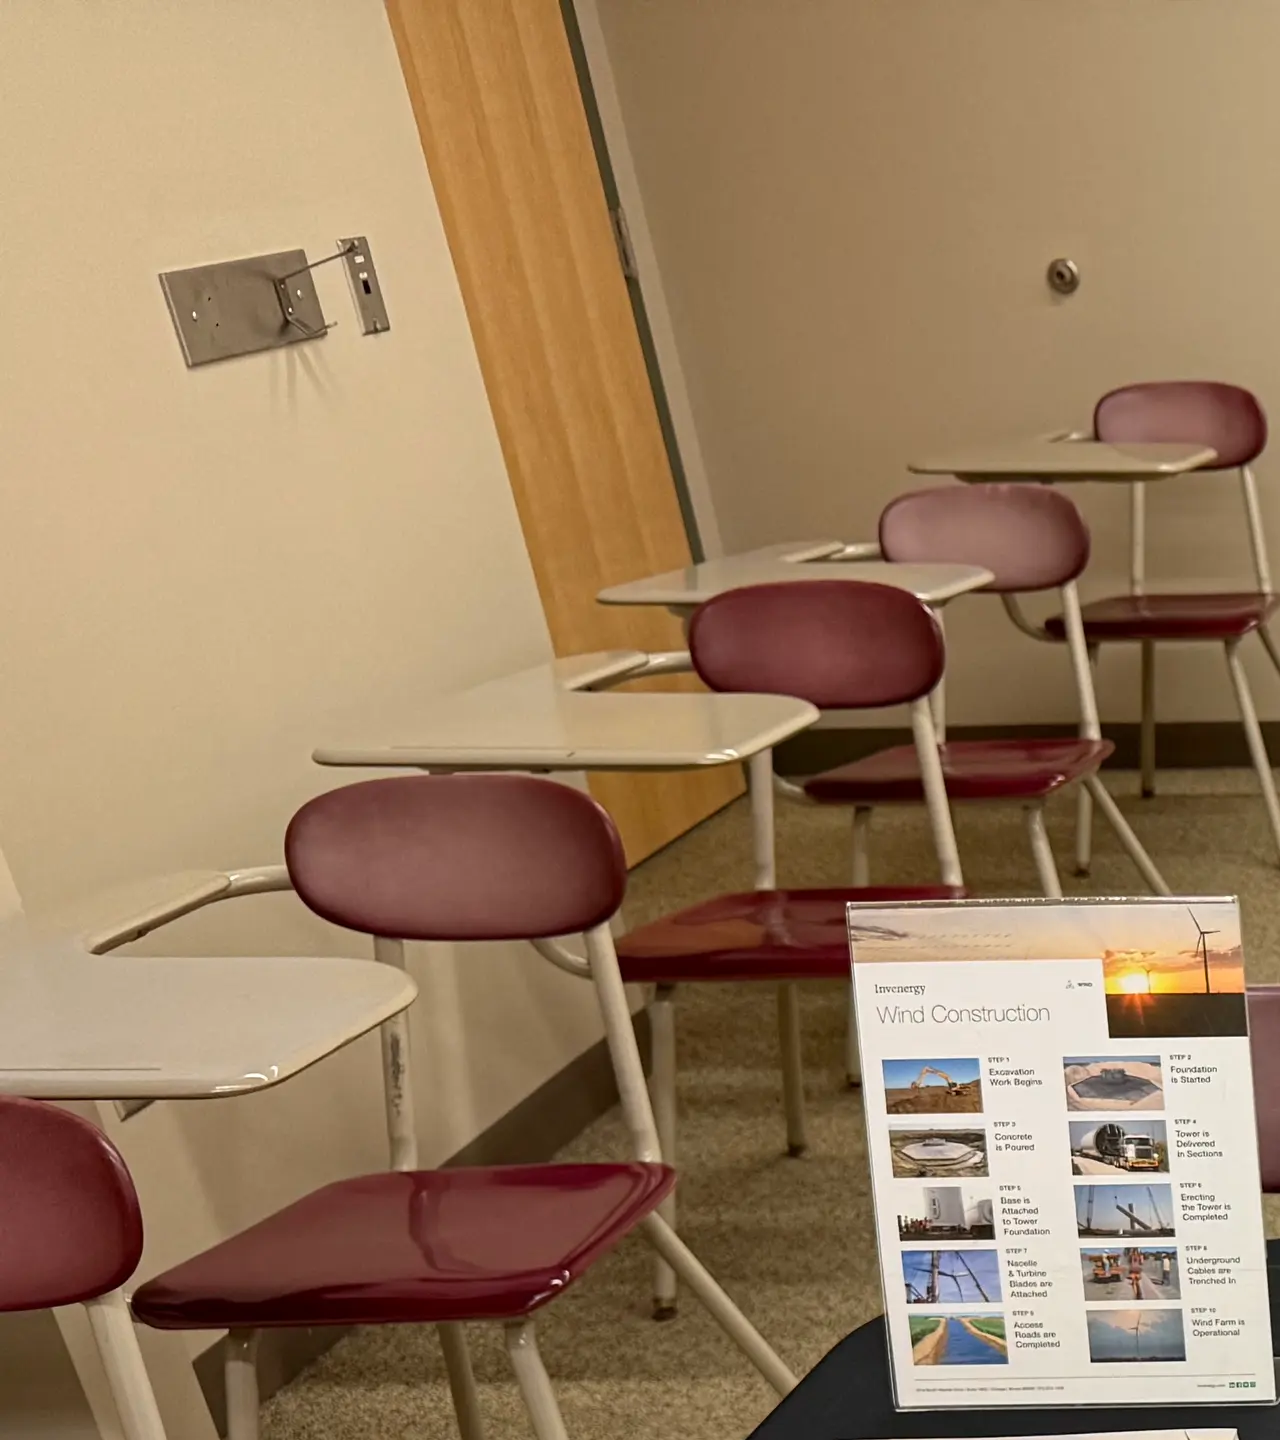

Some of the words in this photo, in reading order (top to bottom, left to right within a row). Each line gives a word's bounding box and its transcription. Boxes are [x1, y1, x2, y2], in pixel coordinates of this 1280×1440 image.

[875, 984, 926, 995] Invenergy
[876, 1005, 925, 1024] Wind
[931, 1004, 1050, 1023] Construction
[989, 1068, 1034, 1076] Excavation
[990, 1078, 1011, 1086] Work
[1014, 1078, 1042, 1087] Begins
[995, 1133, 1032, 1141] Concrete
[1005, 1143, 1035, 1151] Poured
[1176, 1140, 1215, 1148] Delivered
[1187, 1150, 1223, 1158] Sections
[1180, 1193, 1215, 1202] Erecting
[1001, 1207, 1039, 1215] Attached
[1197, 1203, 1222, 1211] Tower
[1182, 1213, 1228, 1221] Completed
[1186, 1257, 1240, 1265] Underground
[1009, 1280, 1037, 1288] Blades
[1010, 1290, 1048, 1298] Attached
[1192, 1329, 1240, 1338] Operational
[1015, 1340, 1060, 1349] Completed
